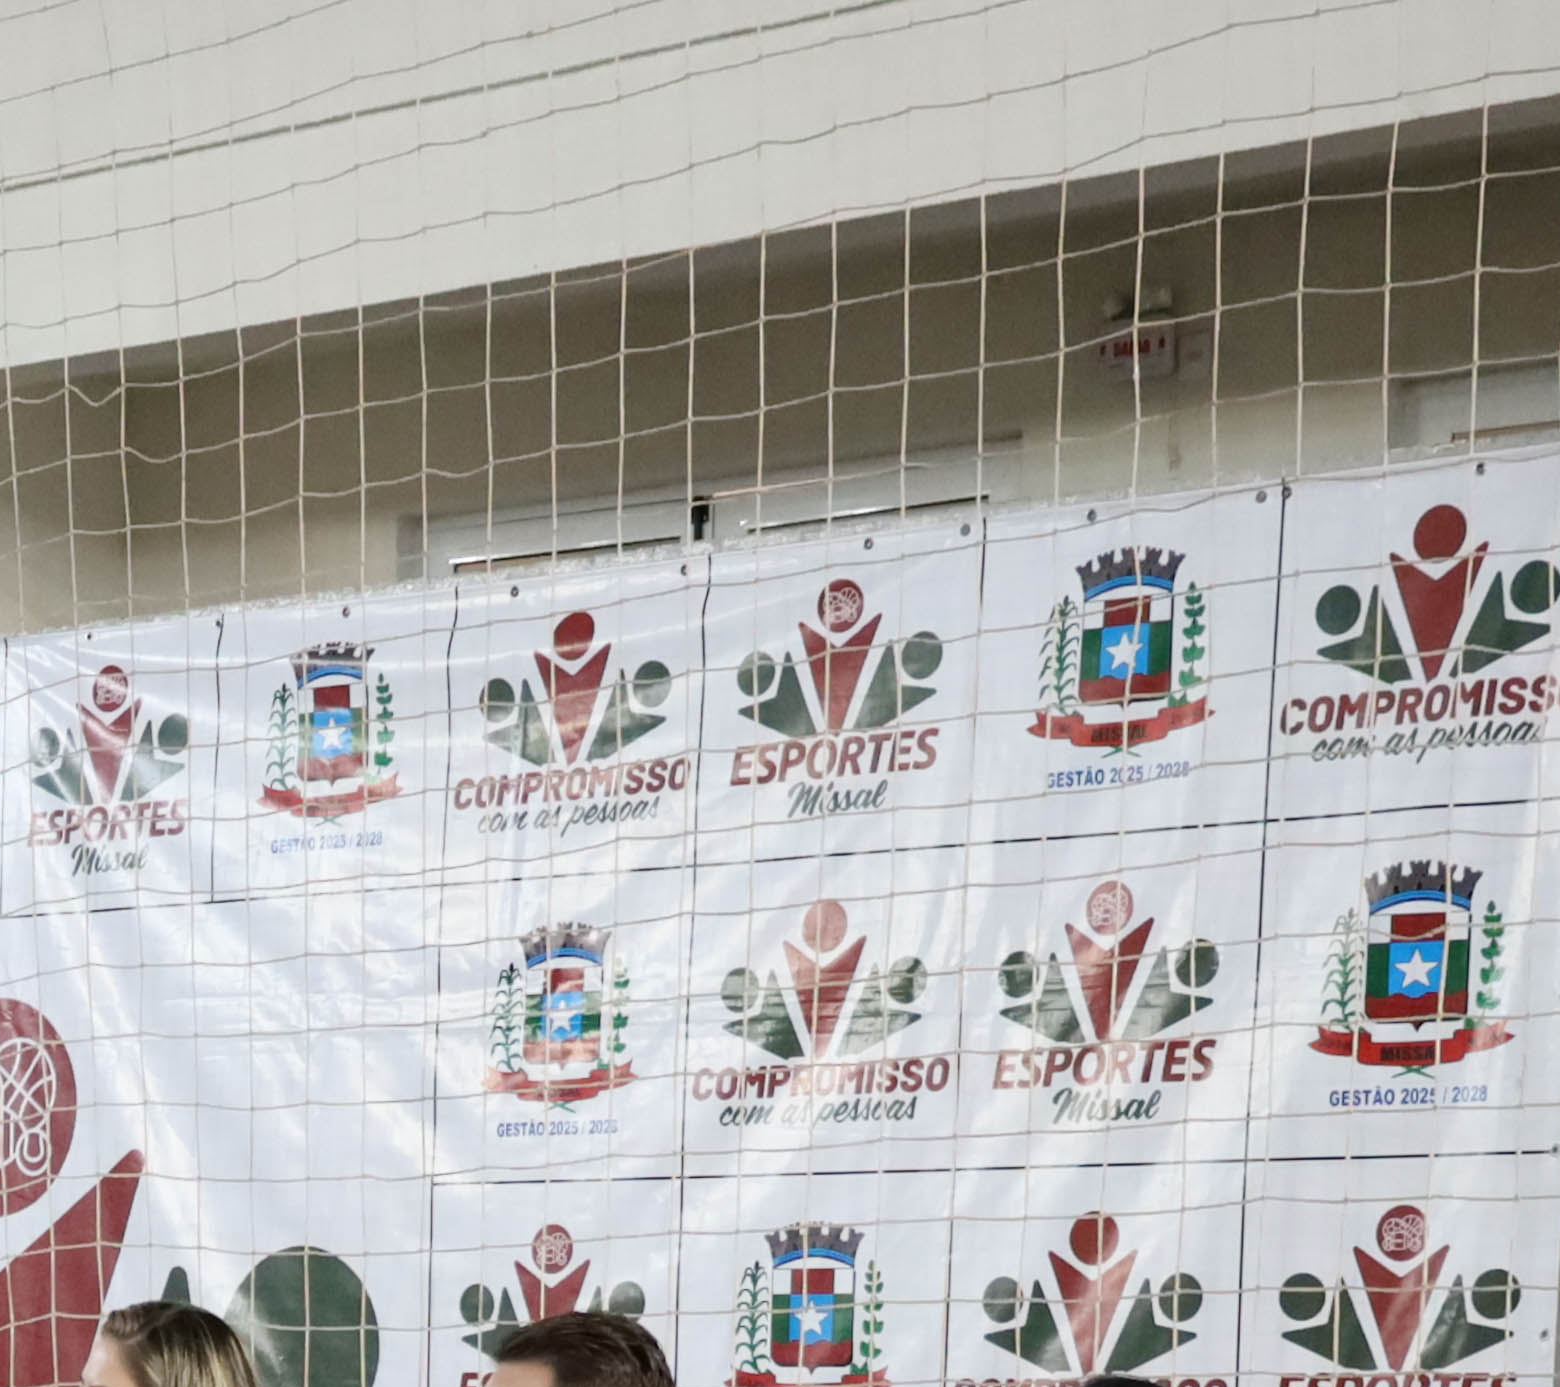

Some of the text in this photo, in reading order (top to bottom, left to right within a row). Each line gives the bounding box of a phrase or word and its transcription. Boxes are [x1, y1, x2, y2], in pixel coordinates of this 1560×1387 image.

[729, 727, 941, 787] ESPORTES
[454, 757, 691, 811] COMPROMISSO
[1047, 765, 1105, 790] GESTÃO
[787, 780, 888, 819] Missal
[27, 799, 186, 849] ESPORTES
[69, 843, 149, 878] Missal
[691, 1056, 951, 1102] COMPROMISSO
[992, 1037, 1217, 1091] ESPORTES
[1052, 1088, 1161, 1124] Missal
[1329, 1085, 1395, 1108] GESTÃO
[1453, 1084, 1487, 1104] 2028
[496, 1119, 545, 1138] GESTÃO
[549, 1119, 578, 1137] 2025
